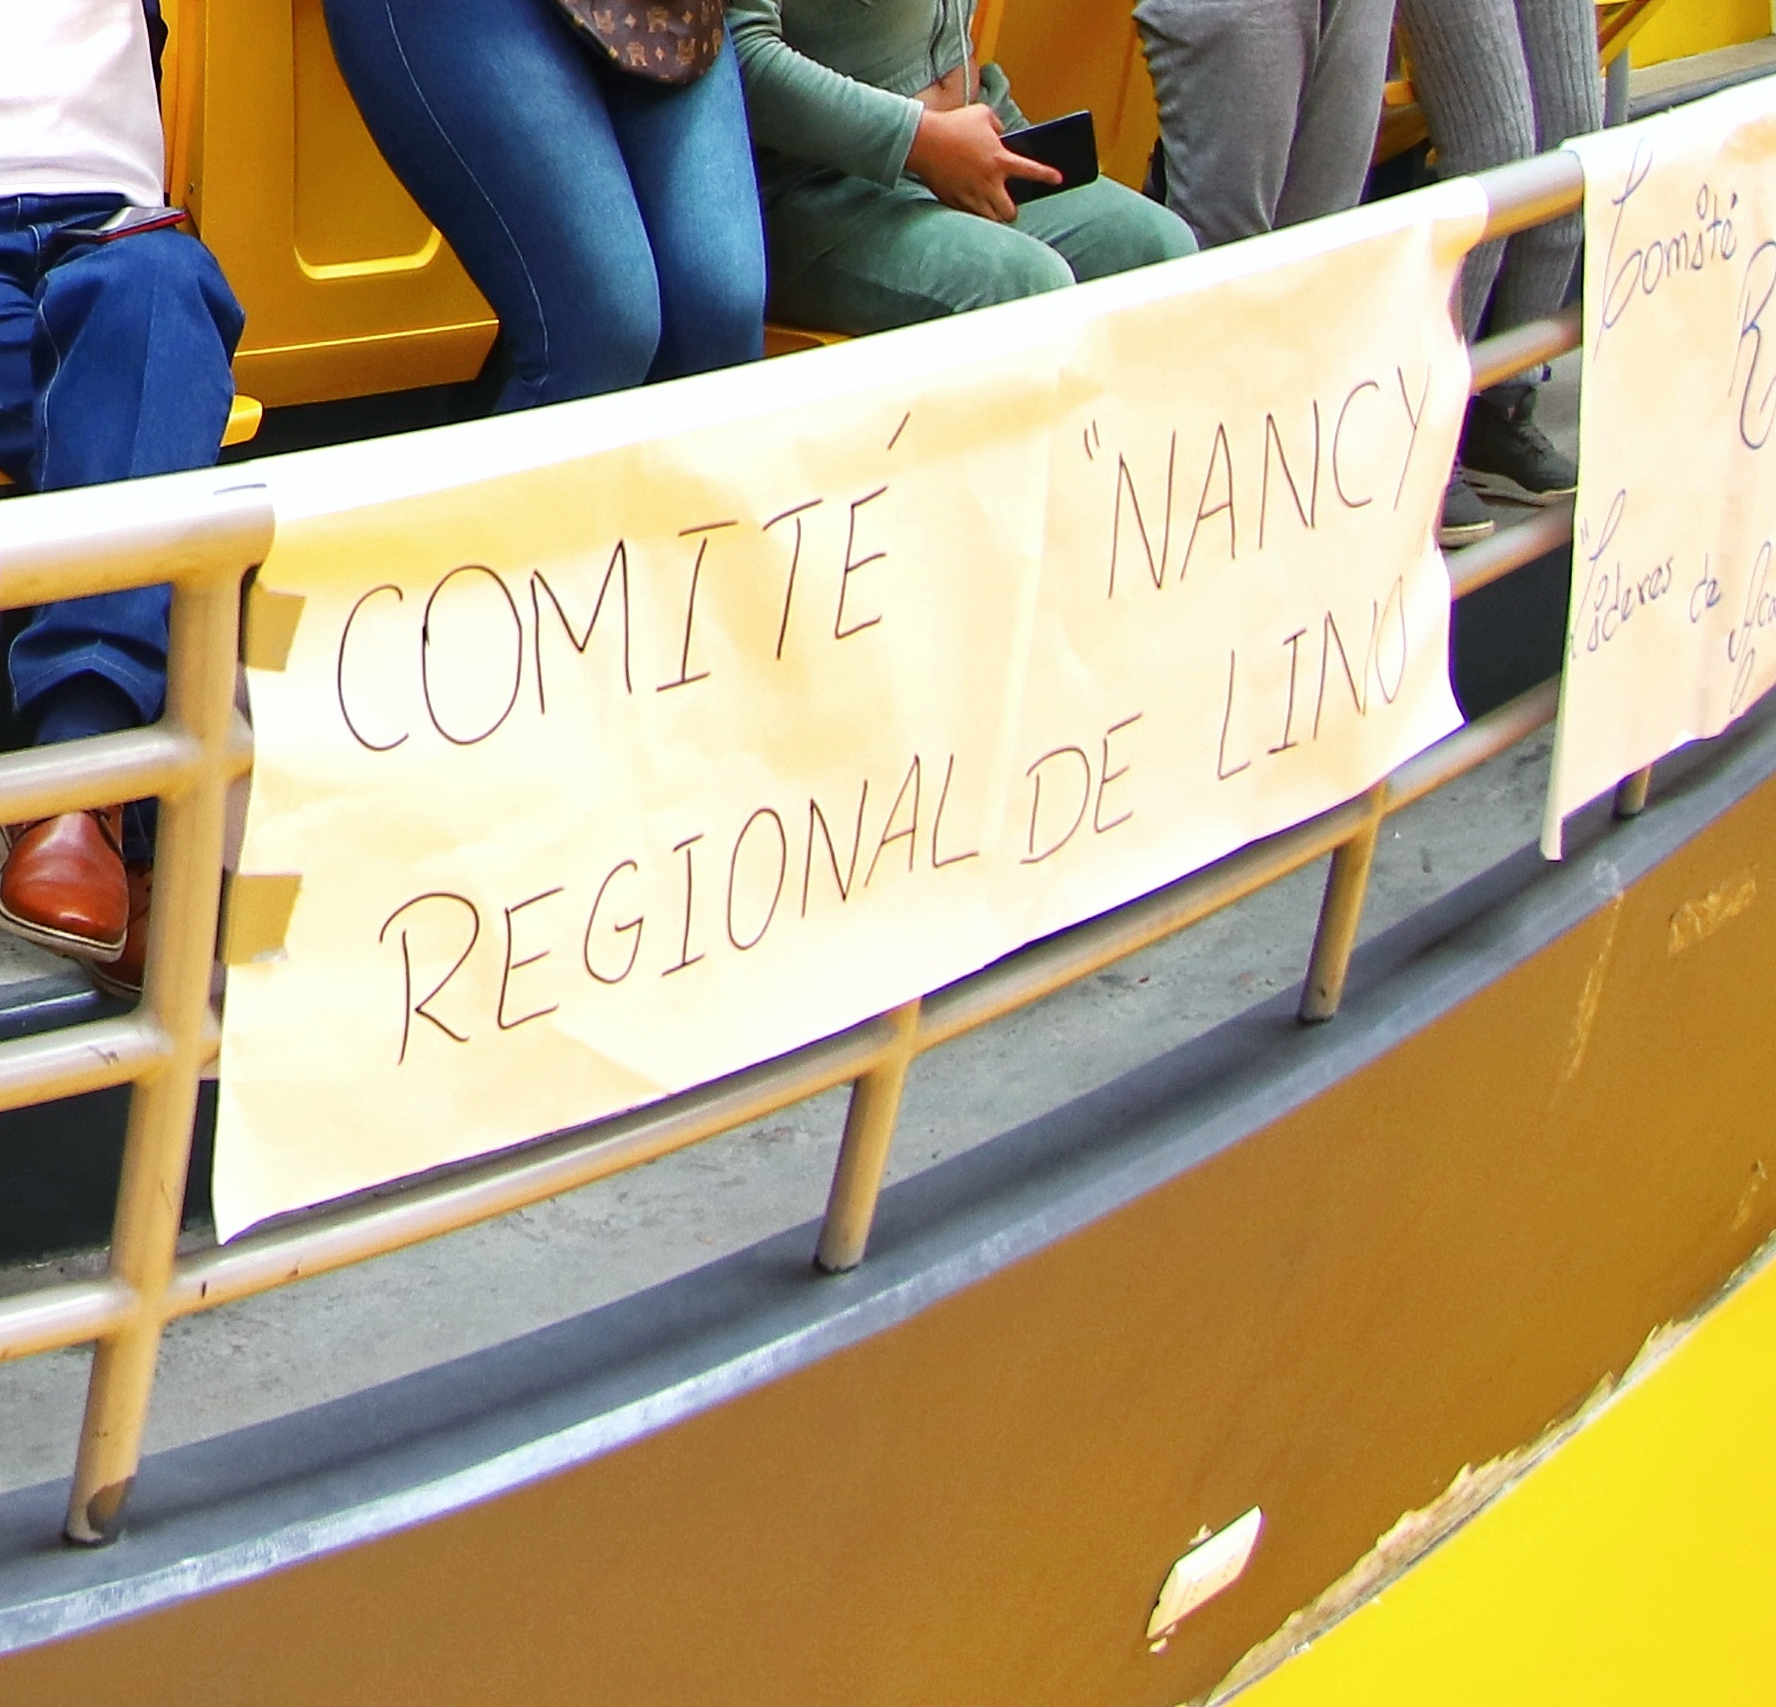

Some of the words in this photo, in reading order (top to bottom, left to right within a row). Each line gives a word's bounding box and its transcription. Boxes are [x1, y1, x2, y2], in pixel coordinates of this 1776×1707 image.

[337, 412, 912, 754] COMITÉ
[378, 751, 980, 1069] REGIONAL
[1020, 711, 1144, 869] DE
